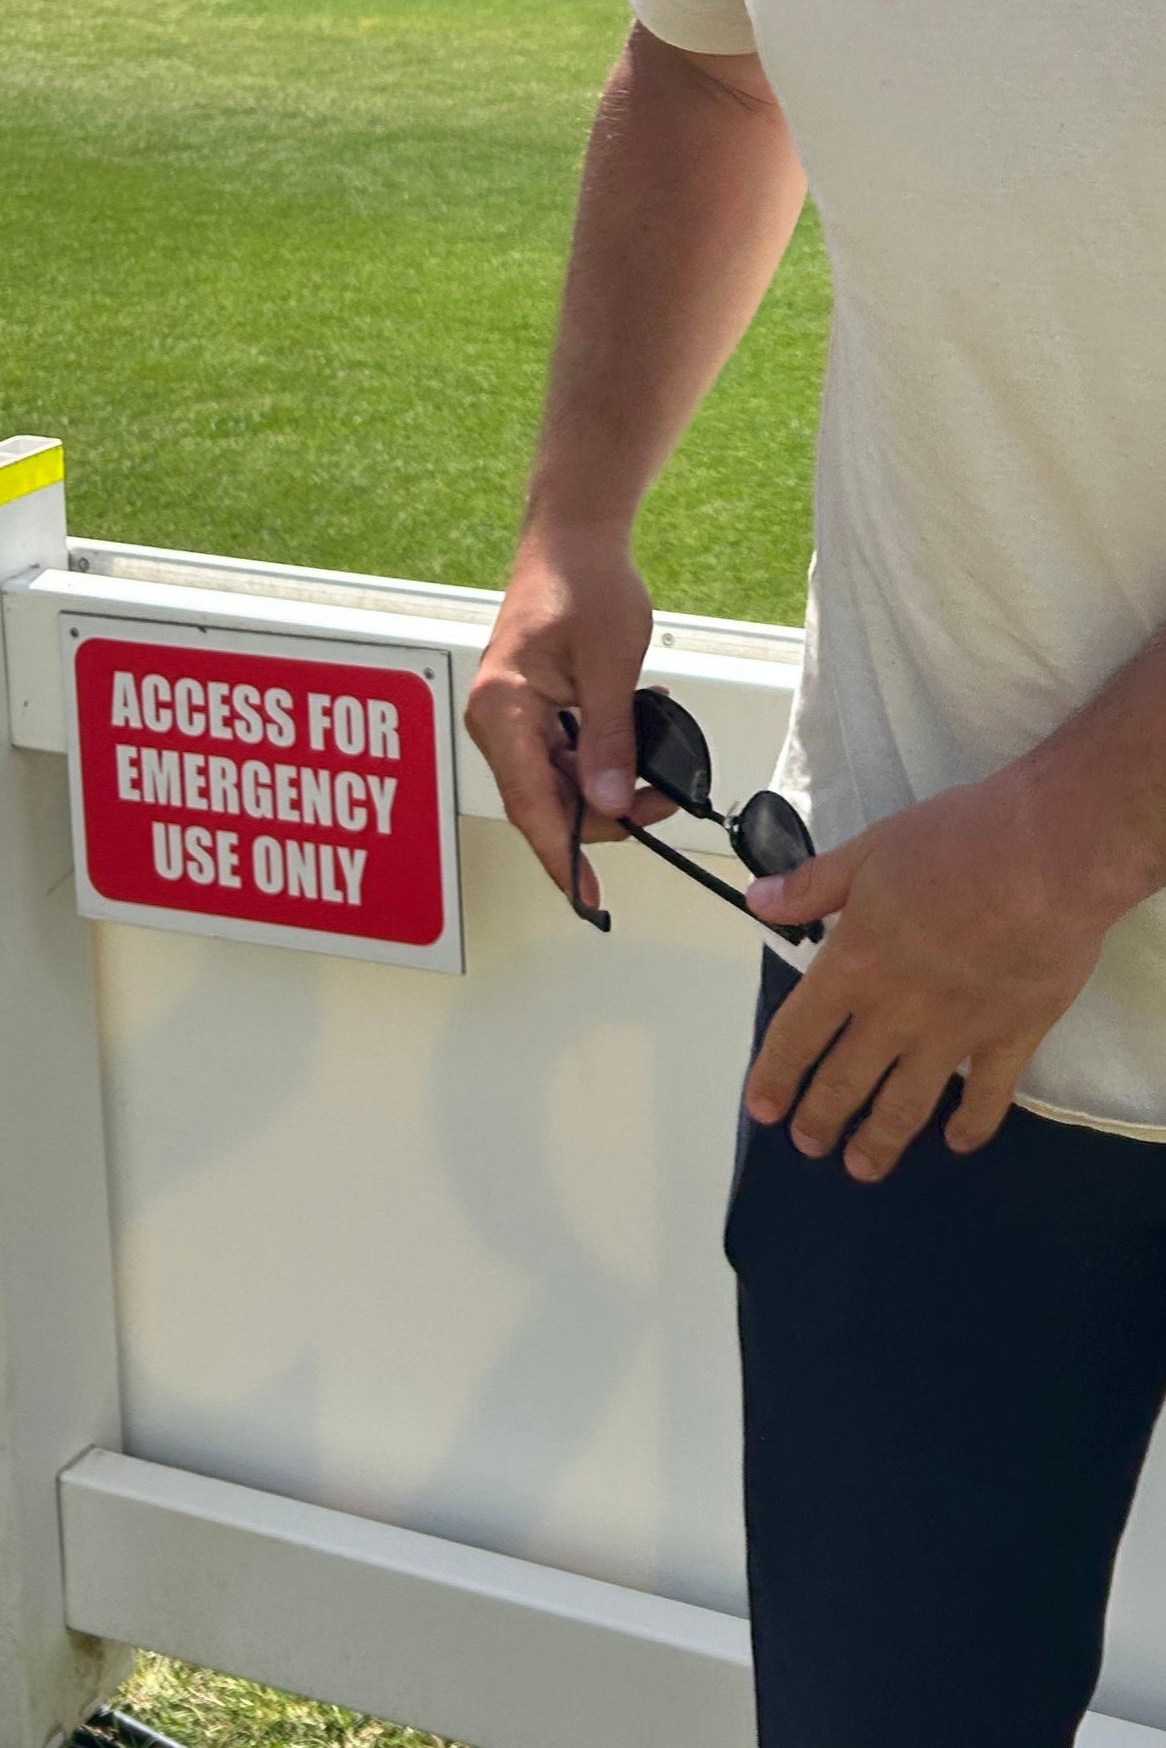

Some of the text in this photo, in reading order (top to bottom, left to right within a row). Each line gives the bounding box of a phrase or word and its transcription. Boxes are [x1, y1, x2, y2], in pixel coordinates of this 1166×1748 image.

[110, 670, 400, 760] ACCESS FOR
[115, 744, 398, 835] EMERGENCY
[151, 821, 368, 906] USE ONLY
